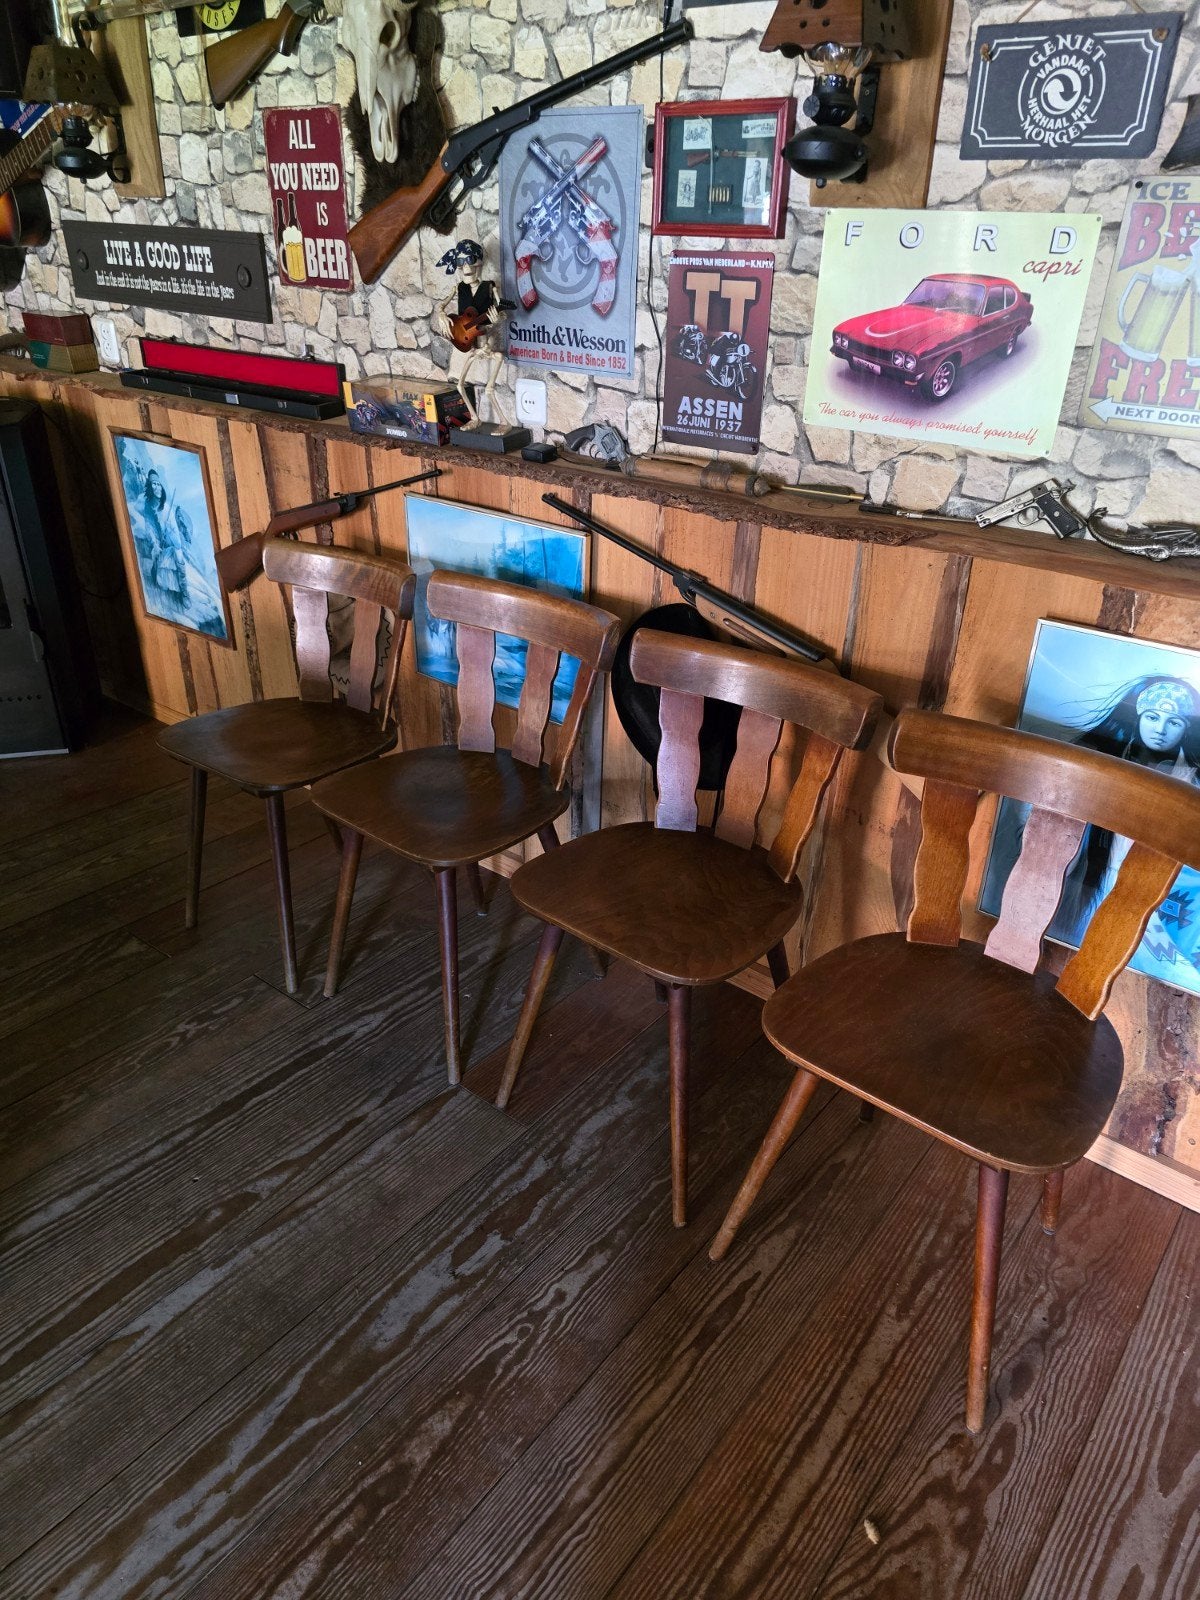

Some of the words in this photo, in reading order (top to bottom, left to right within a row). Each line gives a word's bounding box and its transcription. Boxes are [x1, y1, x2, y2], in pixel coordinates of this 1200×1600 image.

[1029, 34, 1106, 67] GENIET
[1037, 55, 1090, 78] VANDAAG
[1028, 98, 1069, 130] HERHAAL
[1071, 95, 1091, 121] HET
[289, 119, 316, 149] ALL
[1021, 114, 1097, 148] MORGEN
[270, 163, 298, 191] YOU
[301, 163, 339, 191] NEED
[1137, 182, 1191, 200] ICE
[316, 202, 329, 226] IS
[845, 221, 1078, 254] FORD
[103, 239, 132, 266] LIVE
[134, 241, 145, 267] A
[146, 241, 180, 270] GOOD
[182, 244, 214, 273] LIFE
[304, 237, 350, 280] BEER
[714, 258, 745, 267] NEDERLAND
[1023, 259, 1084, 282] capri
[686, 272, 757, 338] TT
[509, 344, 540, 359] American
[541, 349, 558, 362] Born
[560, 351, 565, 362] &
[567, 352, 582, 365] Bred
[585, 353, 606, 367] Since
[607, 356, 626, 370] 1852
[678, 396, 743, 420] ASSEN
[1115, 406, 1155, 419] NEXT
[1158, 411, 1200, 425] DOOR
[677, 414, 689, 425] 26
[689, 416, 710, 428] JUNI
[715, 418, 742, 432] 1937
[818, 402, 836, 415] The
[839, 408, 856, 417] car
[859, 411, 880, 424] you
[882, 411, 922, 429] always
[925, 421, 983, 434] promised
[983, 427, 1039, 445] yourself
